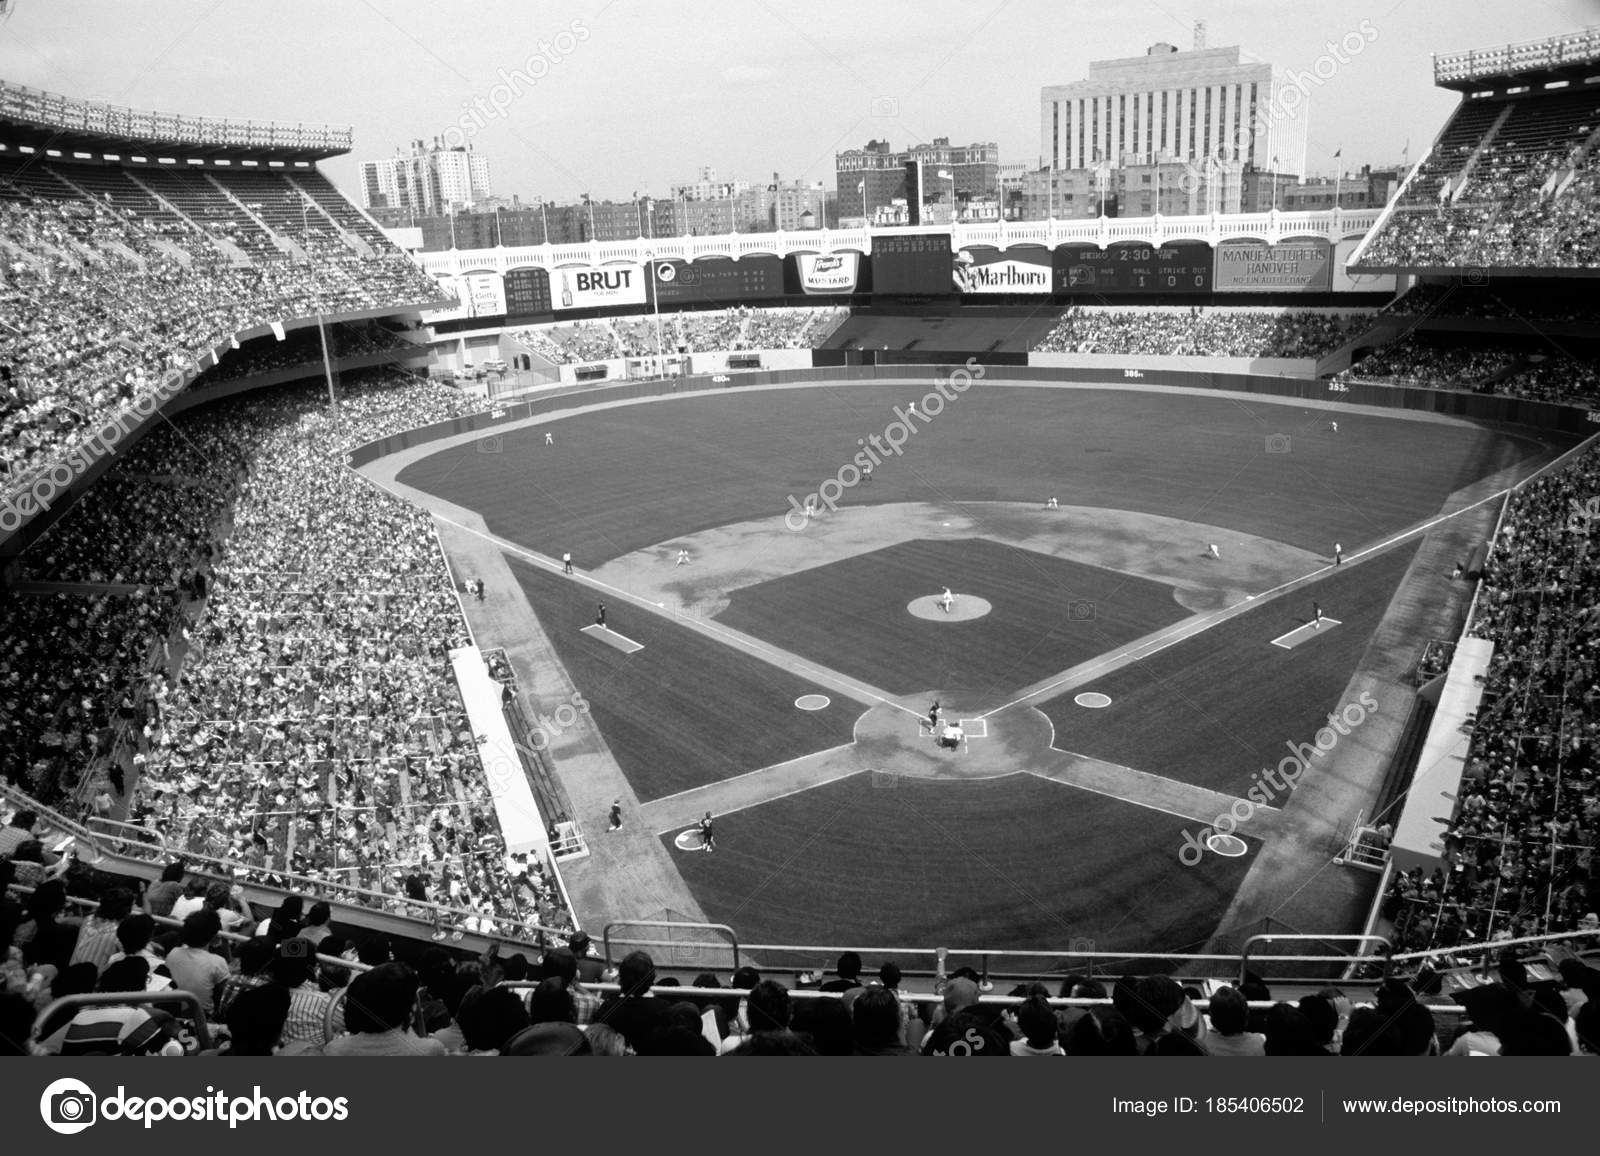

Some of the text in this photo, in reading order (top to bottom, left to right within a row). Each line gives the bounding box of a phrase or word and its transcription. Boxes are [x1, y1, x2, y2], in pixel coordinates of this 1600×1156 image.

[1120, 249, 1150, 261] 2:30
[1223, 248, 1326, 261] MANUFACTURERS
[1159, 267, 1186, 275] STRIKE
[1247, 262, 1298, 274] HANOVER
[576, 269, 632, 291] BRUT
[808, 276, 850, 284] MUSTARD
[978, 265, 1046, 286] Marlboro
[1062, 275, 1204, 288] 17 1 0 0
